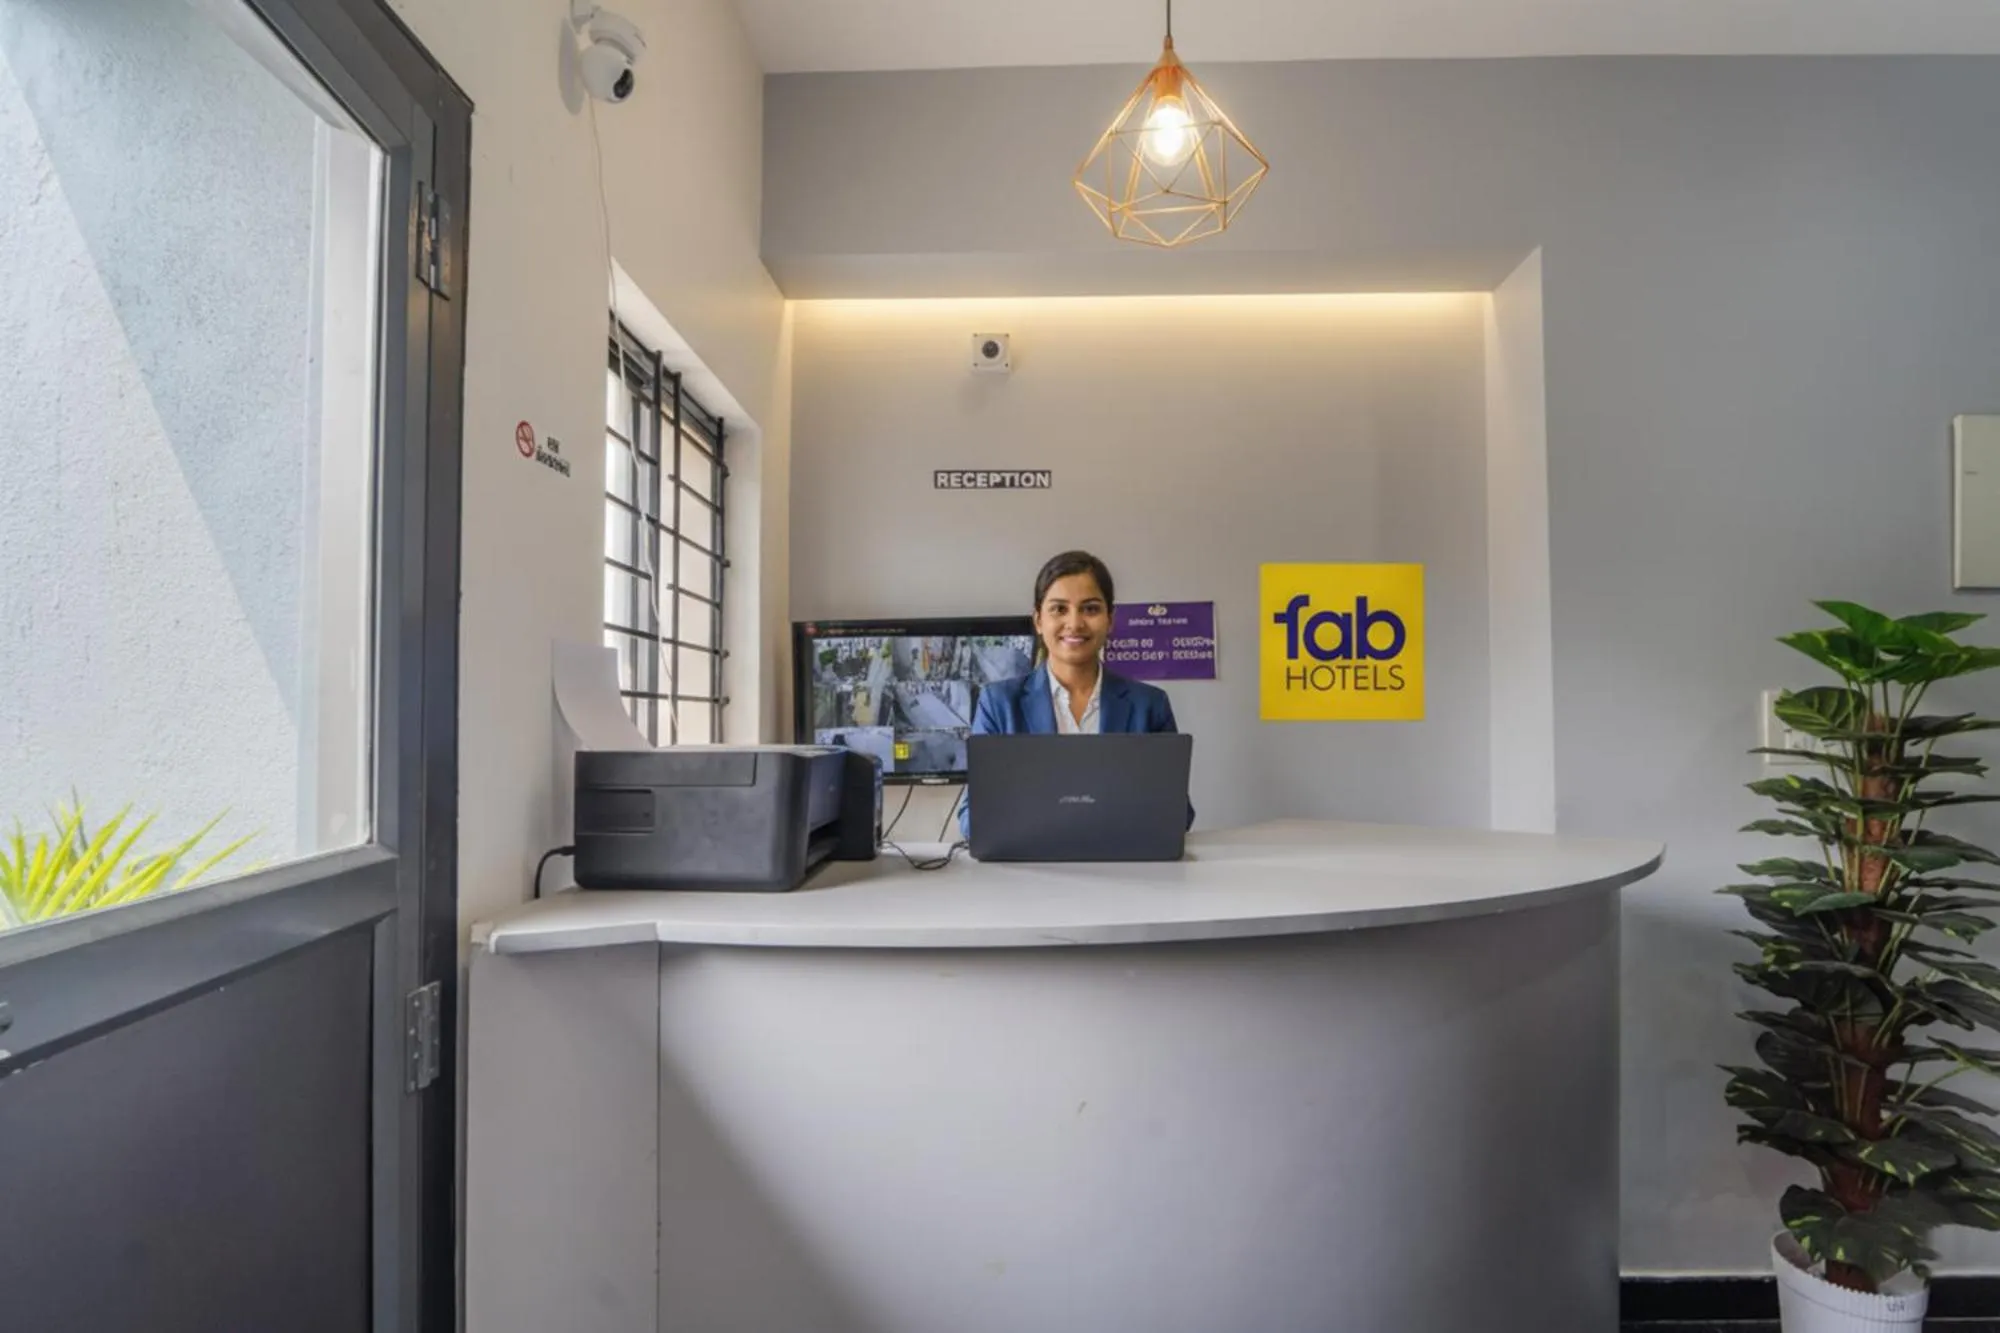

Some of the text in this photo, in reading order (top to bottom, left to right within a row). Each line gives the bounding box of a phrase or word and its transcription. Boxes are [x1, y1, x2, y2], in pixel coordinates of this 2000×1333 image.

[936, 471, 1050, 488] RECEPTION
[1273, 594, 1406, 661] fab
[1286, 664, 1406, 692] HOTELS
